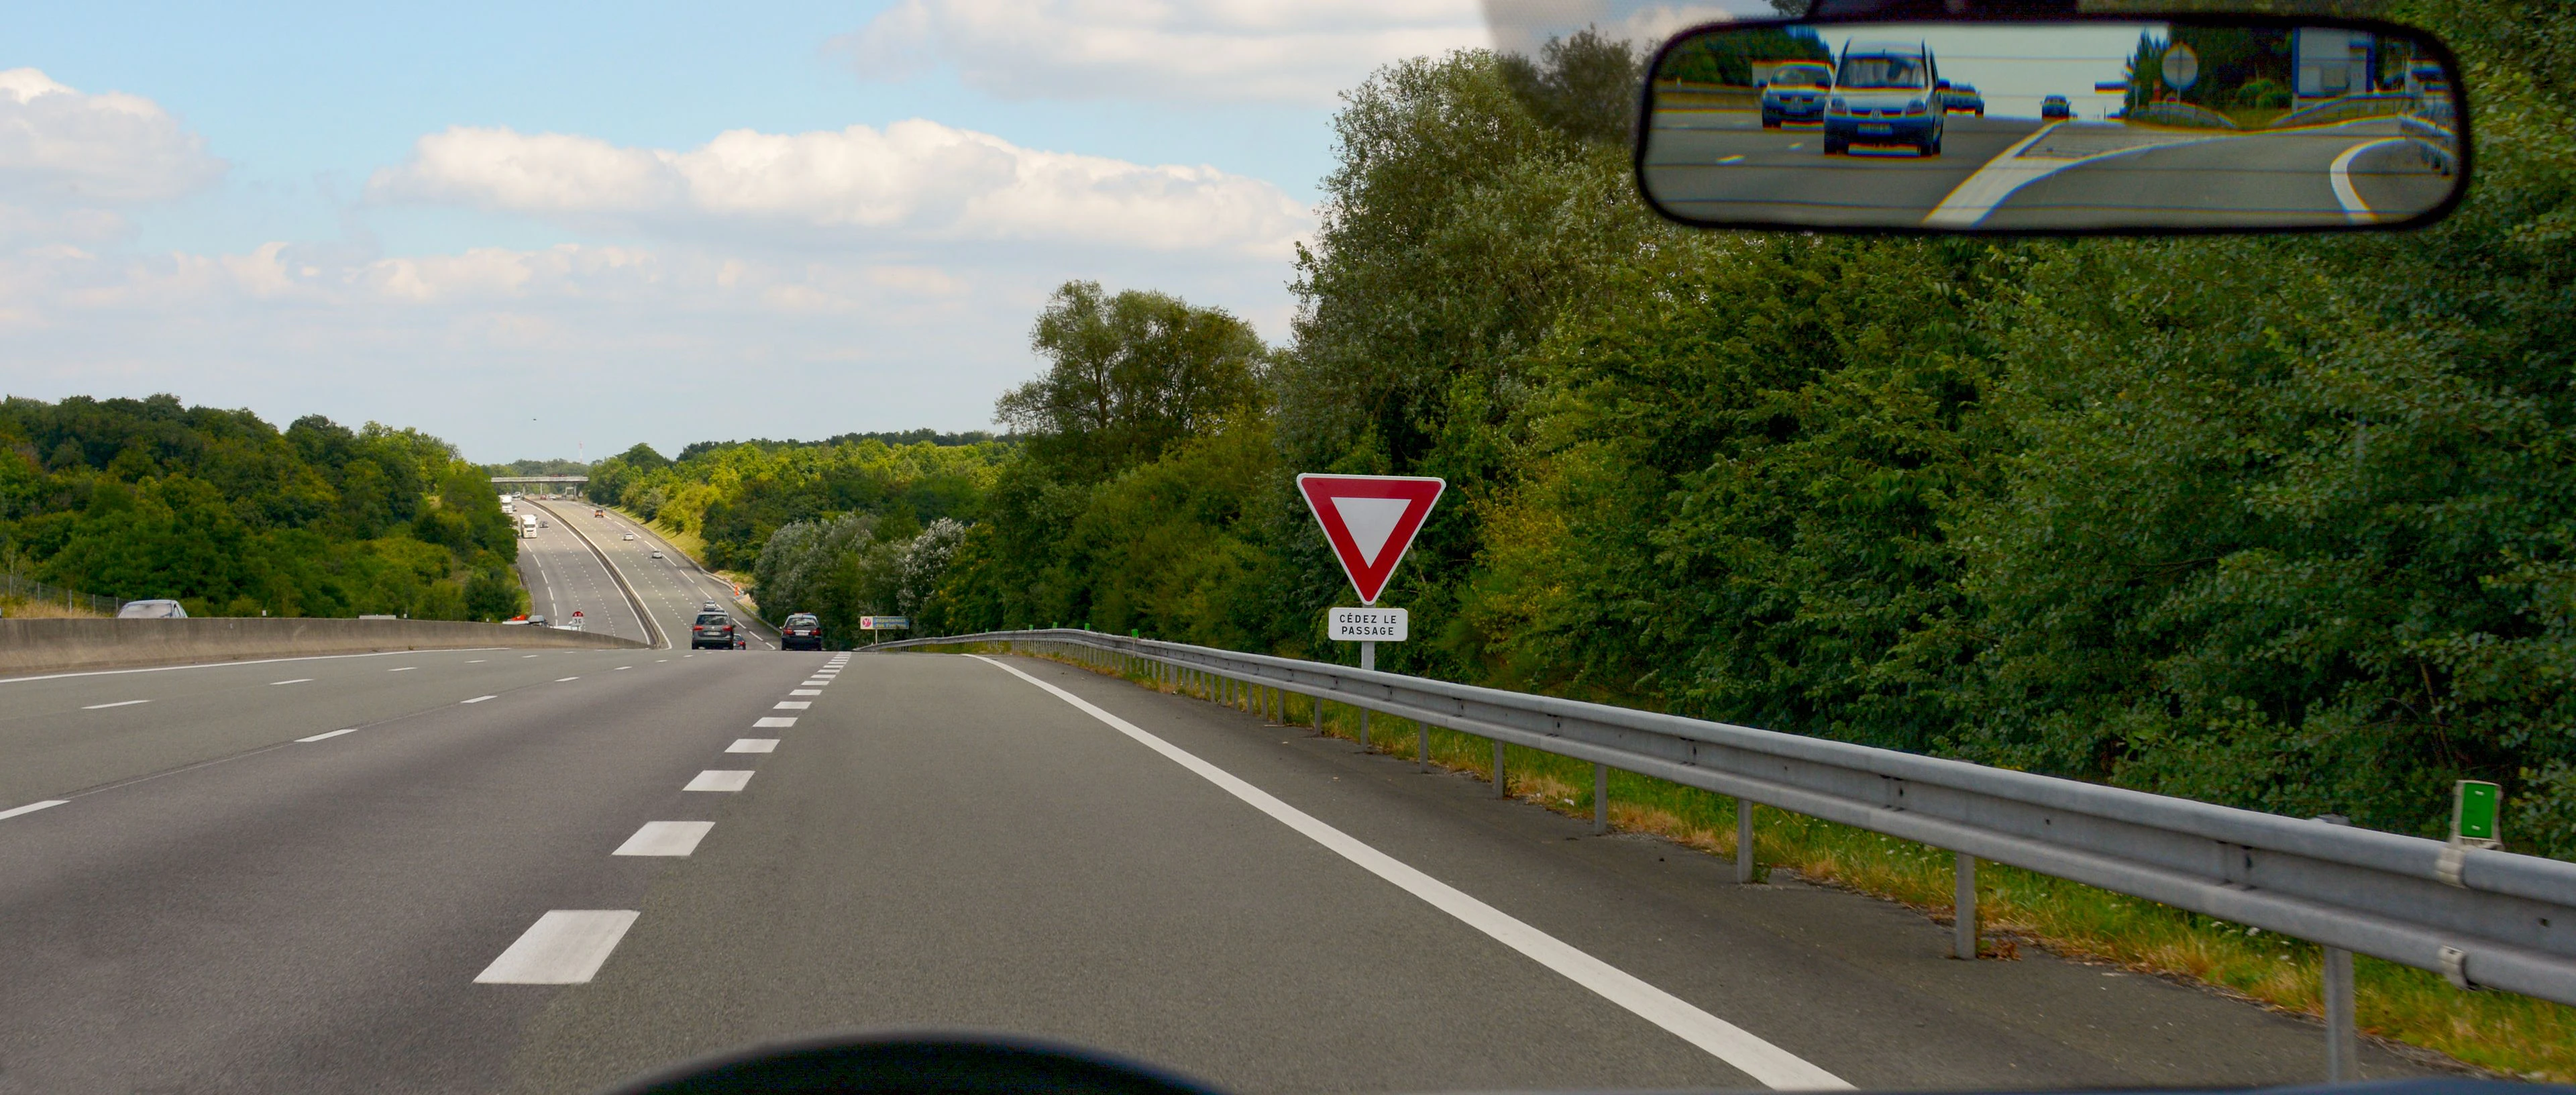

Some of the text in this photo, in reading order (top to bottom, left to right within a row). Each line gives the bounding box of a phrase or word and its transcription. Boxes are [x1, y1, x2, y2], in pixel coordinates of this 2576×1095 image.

[1340, 613, 1397, 623] CÉDEZ LE
[1342, 626, 1394, 635] PASSAGE
